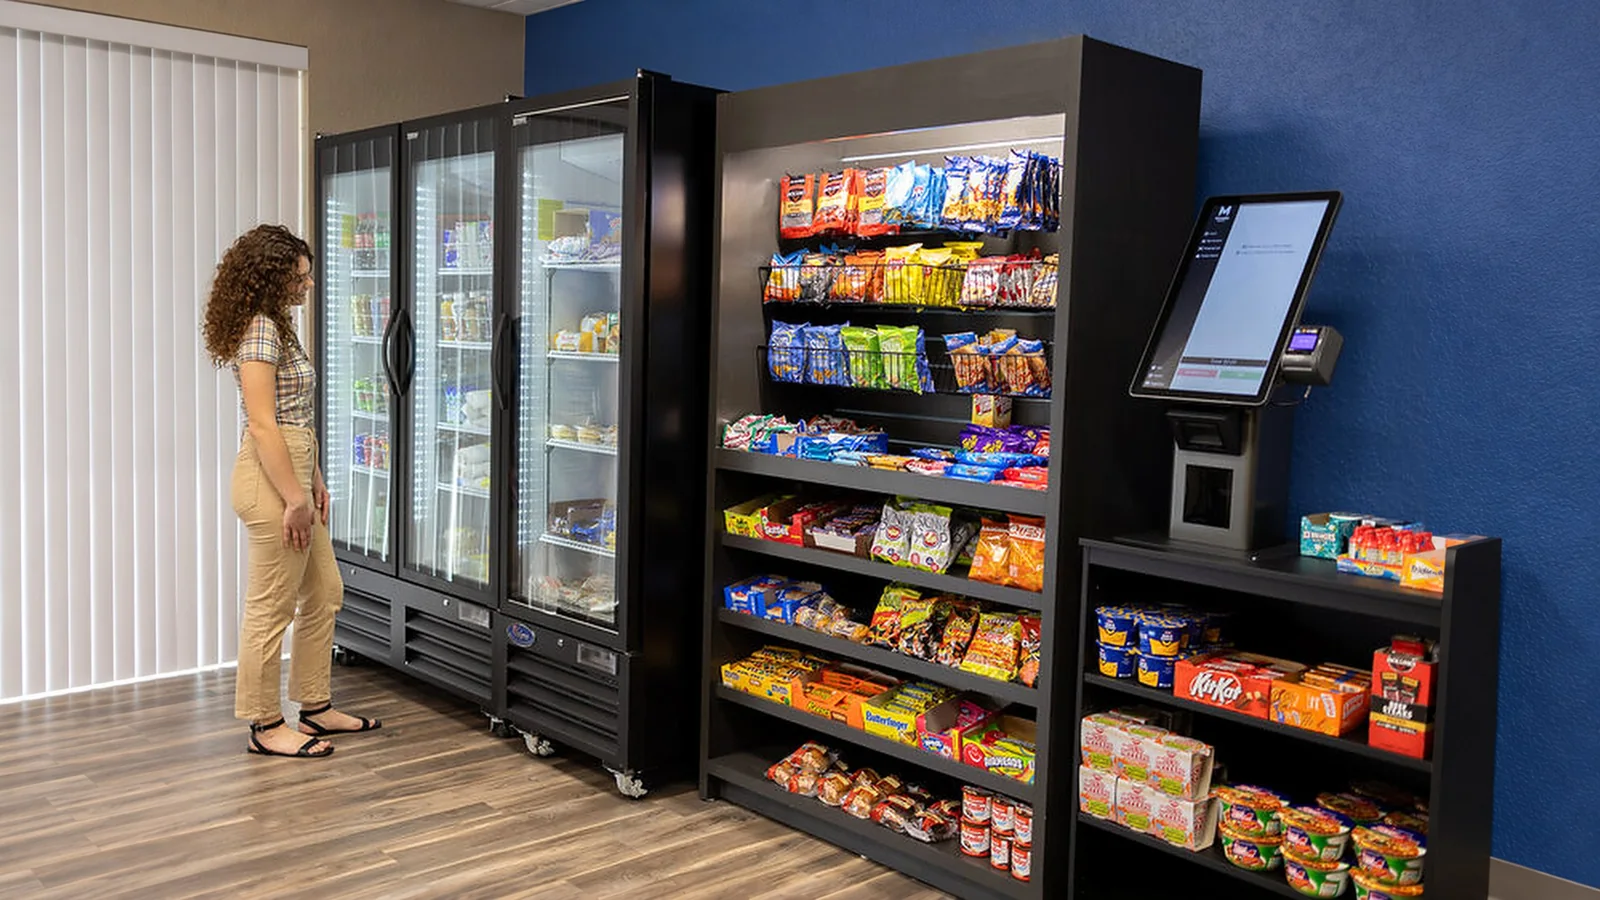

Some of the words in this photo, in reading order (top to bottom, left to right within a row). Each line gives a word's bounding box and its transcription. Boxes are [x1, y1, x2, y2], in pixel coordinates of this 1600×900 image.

[1218, 205, 1231, 216] M
[1009, 524, 1045, 540] QUEST
[1190, 672, 1242, 704] KitKat
[865, 710, 909, 730] Butterfinger
